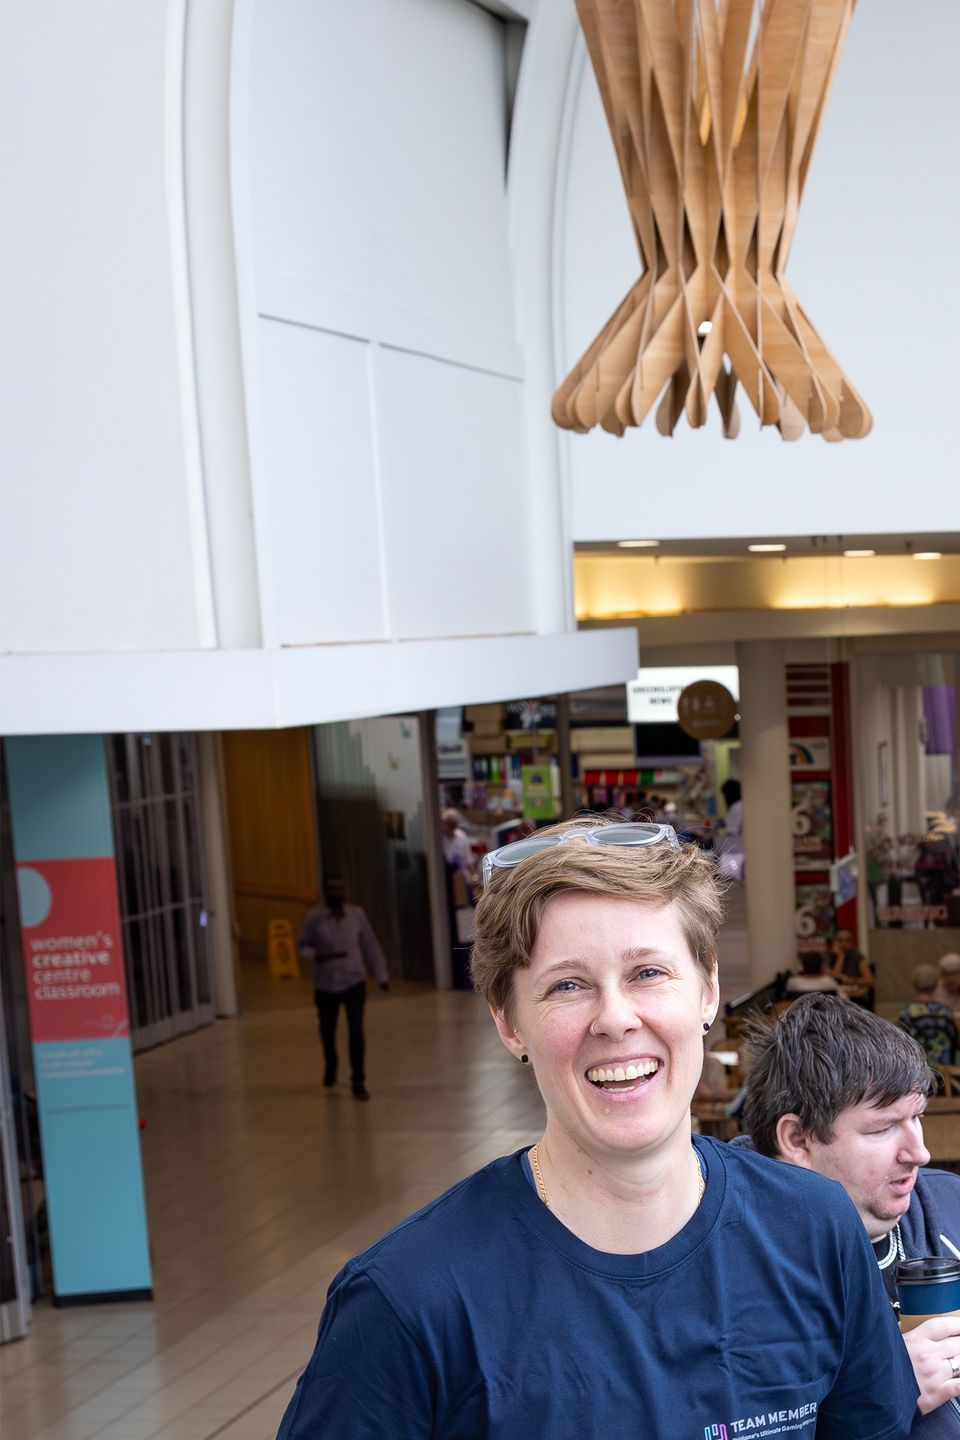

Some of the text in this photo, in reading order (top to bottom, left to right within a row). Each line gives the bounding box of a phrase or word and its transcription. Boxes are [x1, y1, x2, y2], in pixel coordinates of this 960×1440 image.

[31, 931, 113, 950] women's
[31, 950, 111, 969] creative
[32, 967, 92, 985] centre
[34, 981, 121, 1001] classroom
[729, 1413, 767, 1433] TEAM
[767, 1401, 818, 1425] MEMBER
